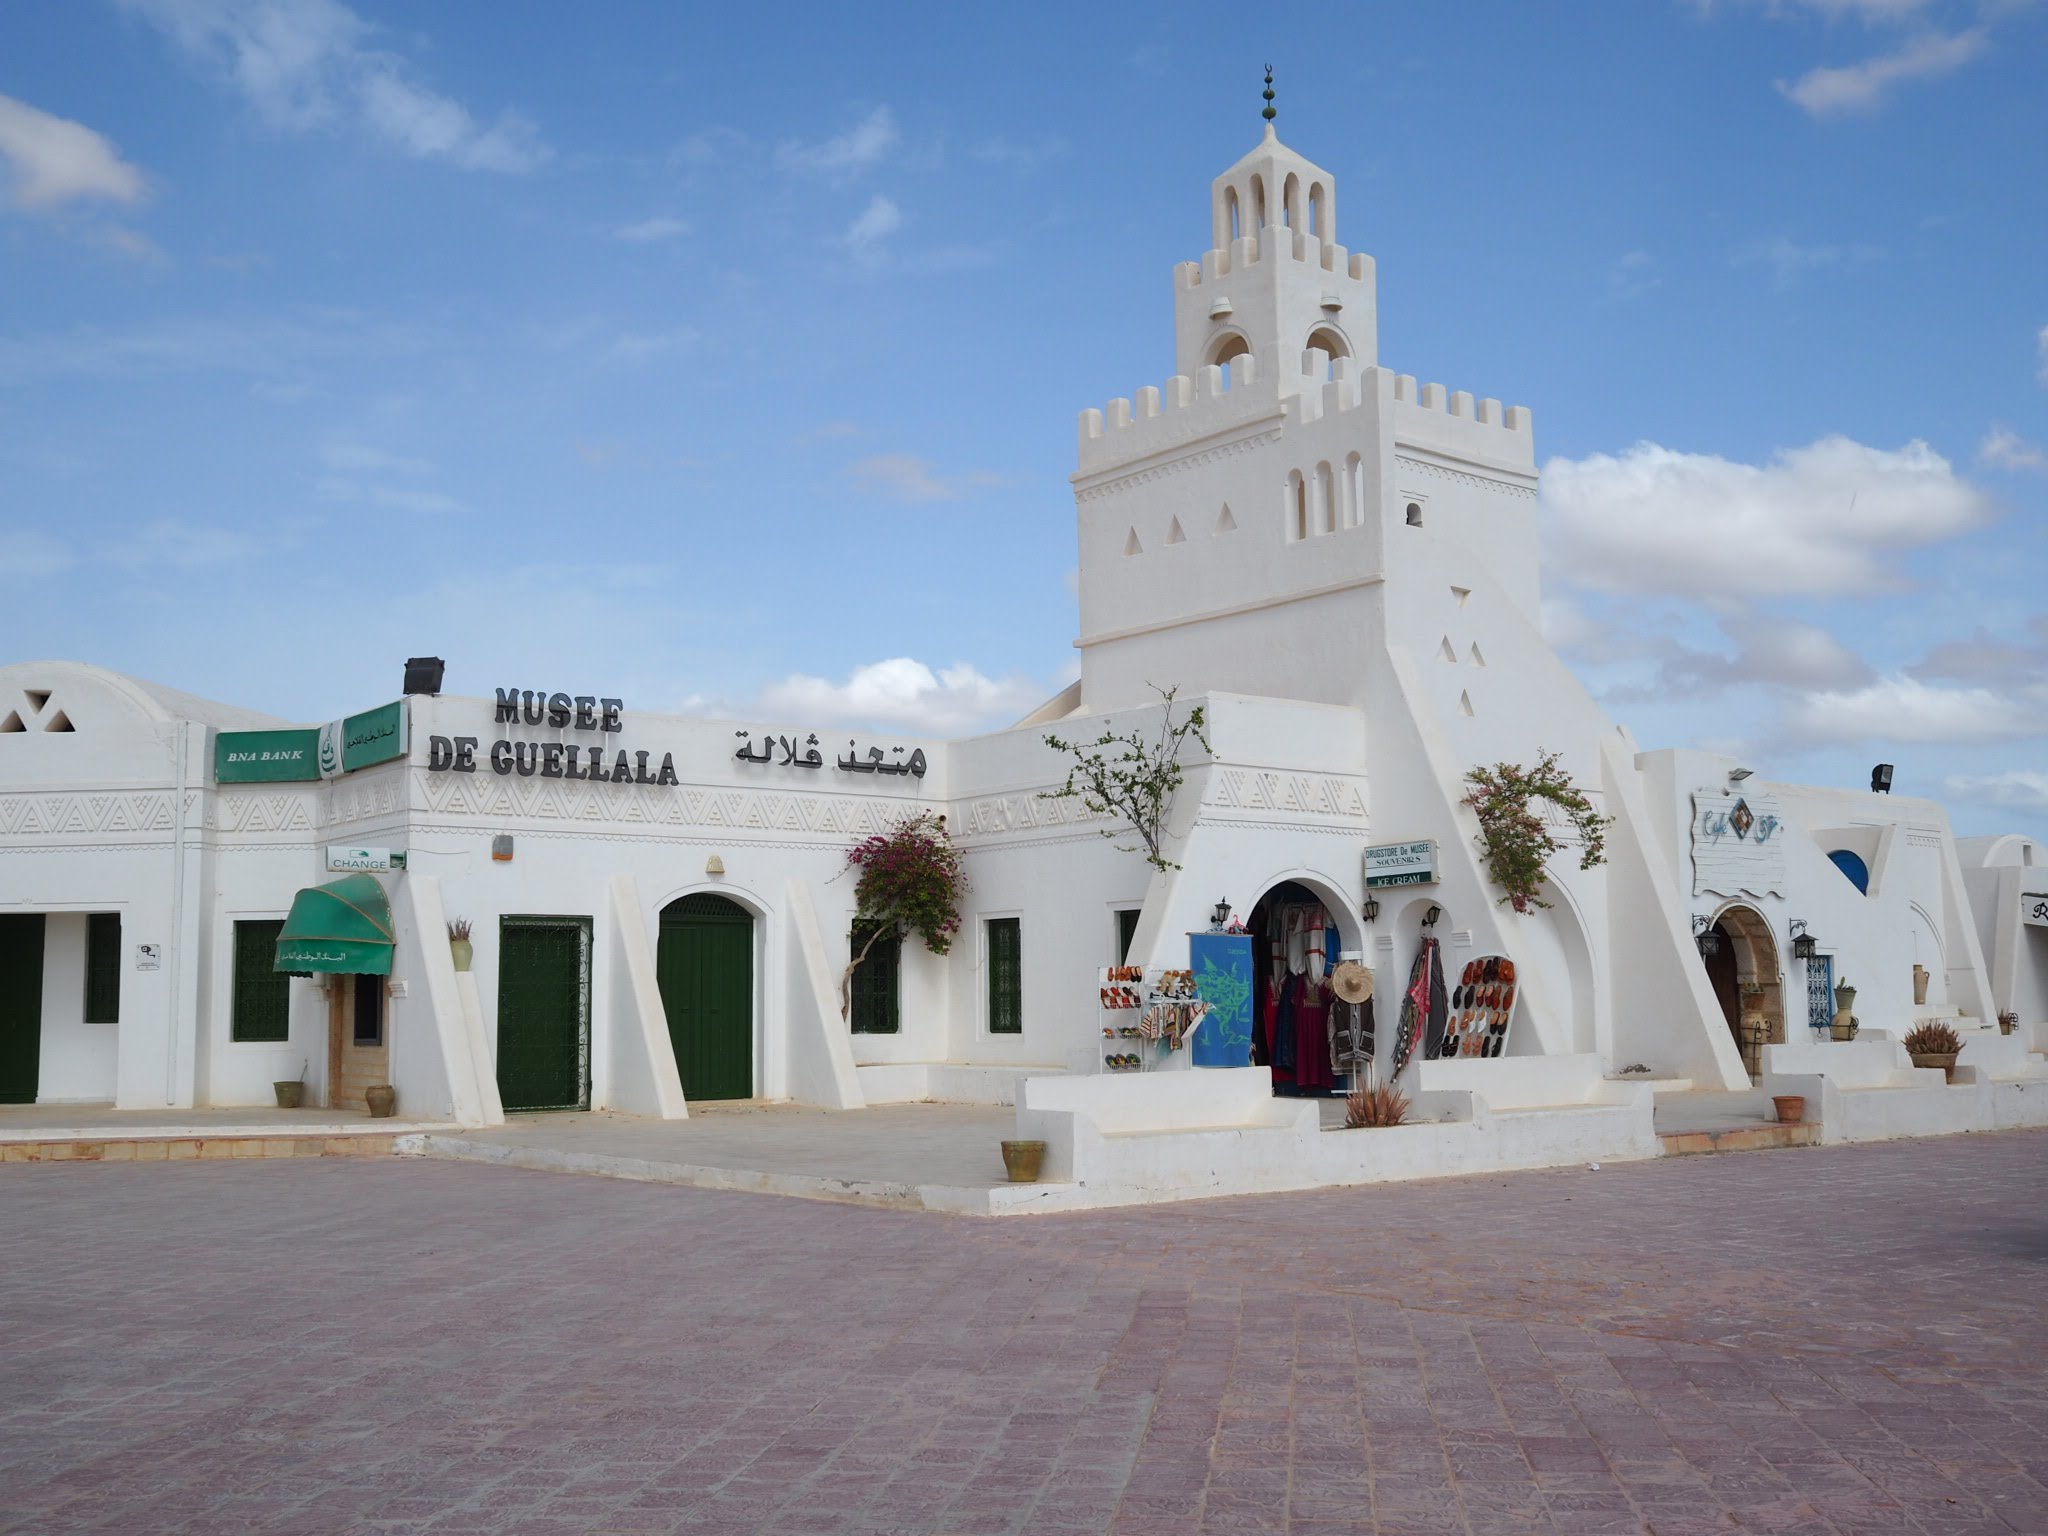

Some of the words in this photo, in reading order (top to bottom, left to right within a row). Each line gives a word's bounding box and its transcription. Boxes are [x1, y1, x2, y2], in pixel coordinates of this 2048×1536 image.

[494, 687, 624, 733] MUSEE
[227, 752, 257, 762] BNA
[260, 750, 304, 761] BANK
[428, 735, 479, 774] DE
[490, 739, 680, 786] GUELLALA
[1365, 847, 1398, 859] DRUGSTORE
[1400, 846, 1408, 856] De
[333, 859, 387, 869] CHANGE
[1375, 856, 1422, 866] SOUVENIRS
[1377, 877, 1390, 887] ICE
[1392, 874, 1420, 885] CREAM
